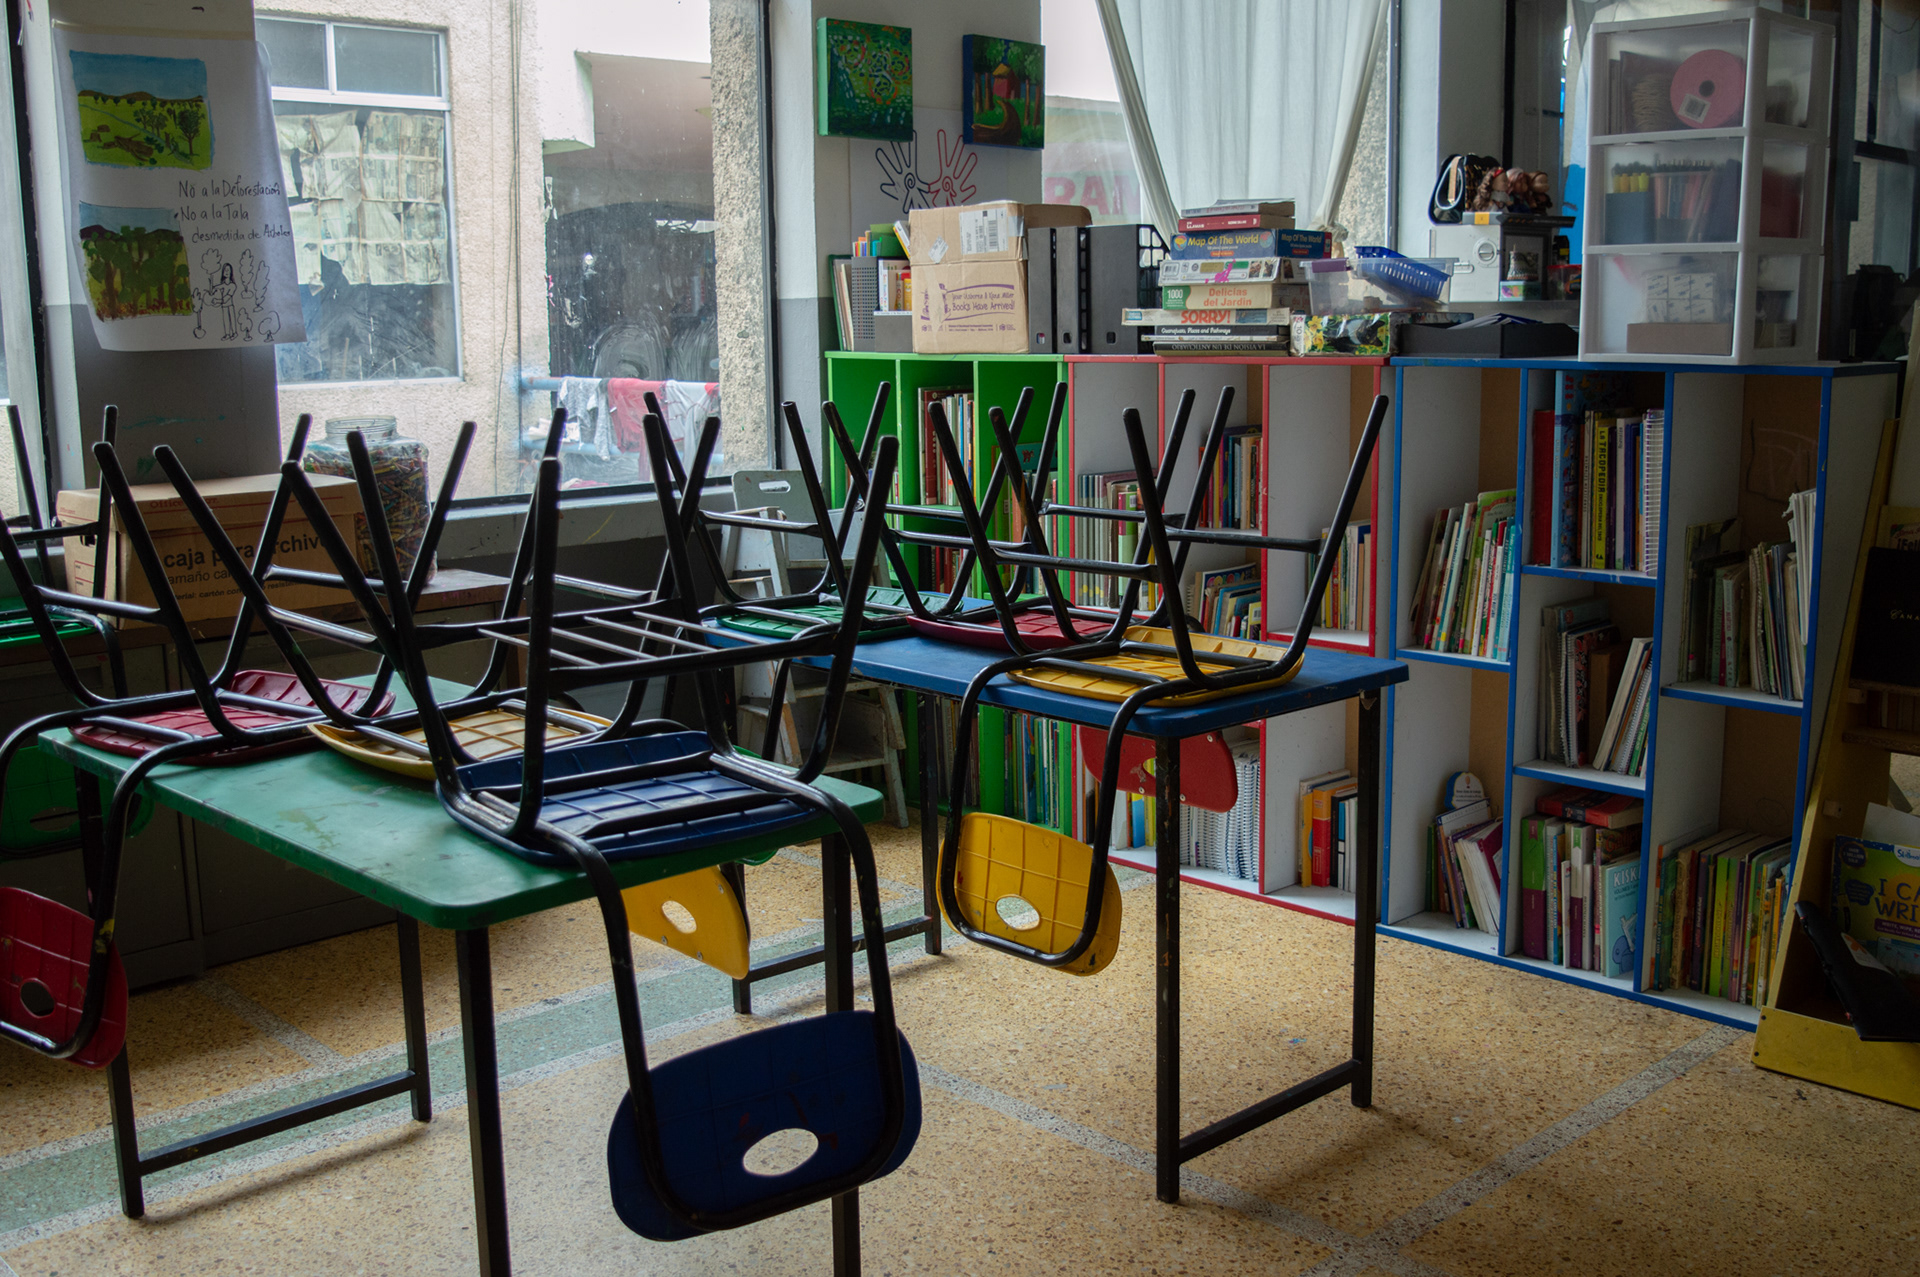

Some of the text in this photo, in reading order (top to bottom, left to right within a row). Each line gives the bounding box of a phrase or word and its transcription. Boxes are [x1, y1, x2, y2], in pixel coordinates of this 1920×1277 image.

[179, 180, 196, 198] No
[202, 186, 208, 197] a
[212, 179, 221, 196] la
[181, 203, 249, 221] No a la Tala
[192, 226, 245, 243] desmedida
[248, 229, 260, 240] de
[1188, 234, 1259, 247] Map Of The World
[1167, 289, 1183, 299] 1000
[1208, 288, 1247, 297] Delicias
[952, 302, 971, 311] Books
[973, 301, 989, 311] Have
[1203, 297, 1252, 306] del Jardin
[1181, 310, 1231, 324] SORRY!
[1598, 430, 1606, 441] LA
[1597, 441, 1607, 493] TACOPEDIA
[164, 548, 205, 571] caja
[212, 545, 255, 567] pra
[168, 571, 210, 585] amaño
[199, 589, 225, 599] cartón
[1613, 867, 1641, 888] KISK
